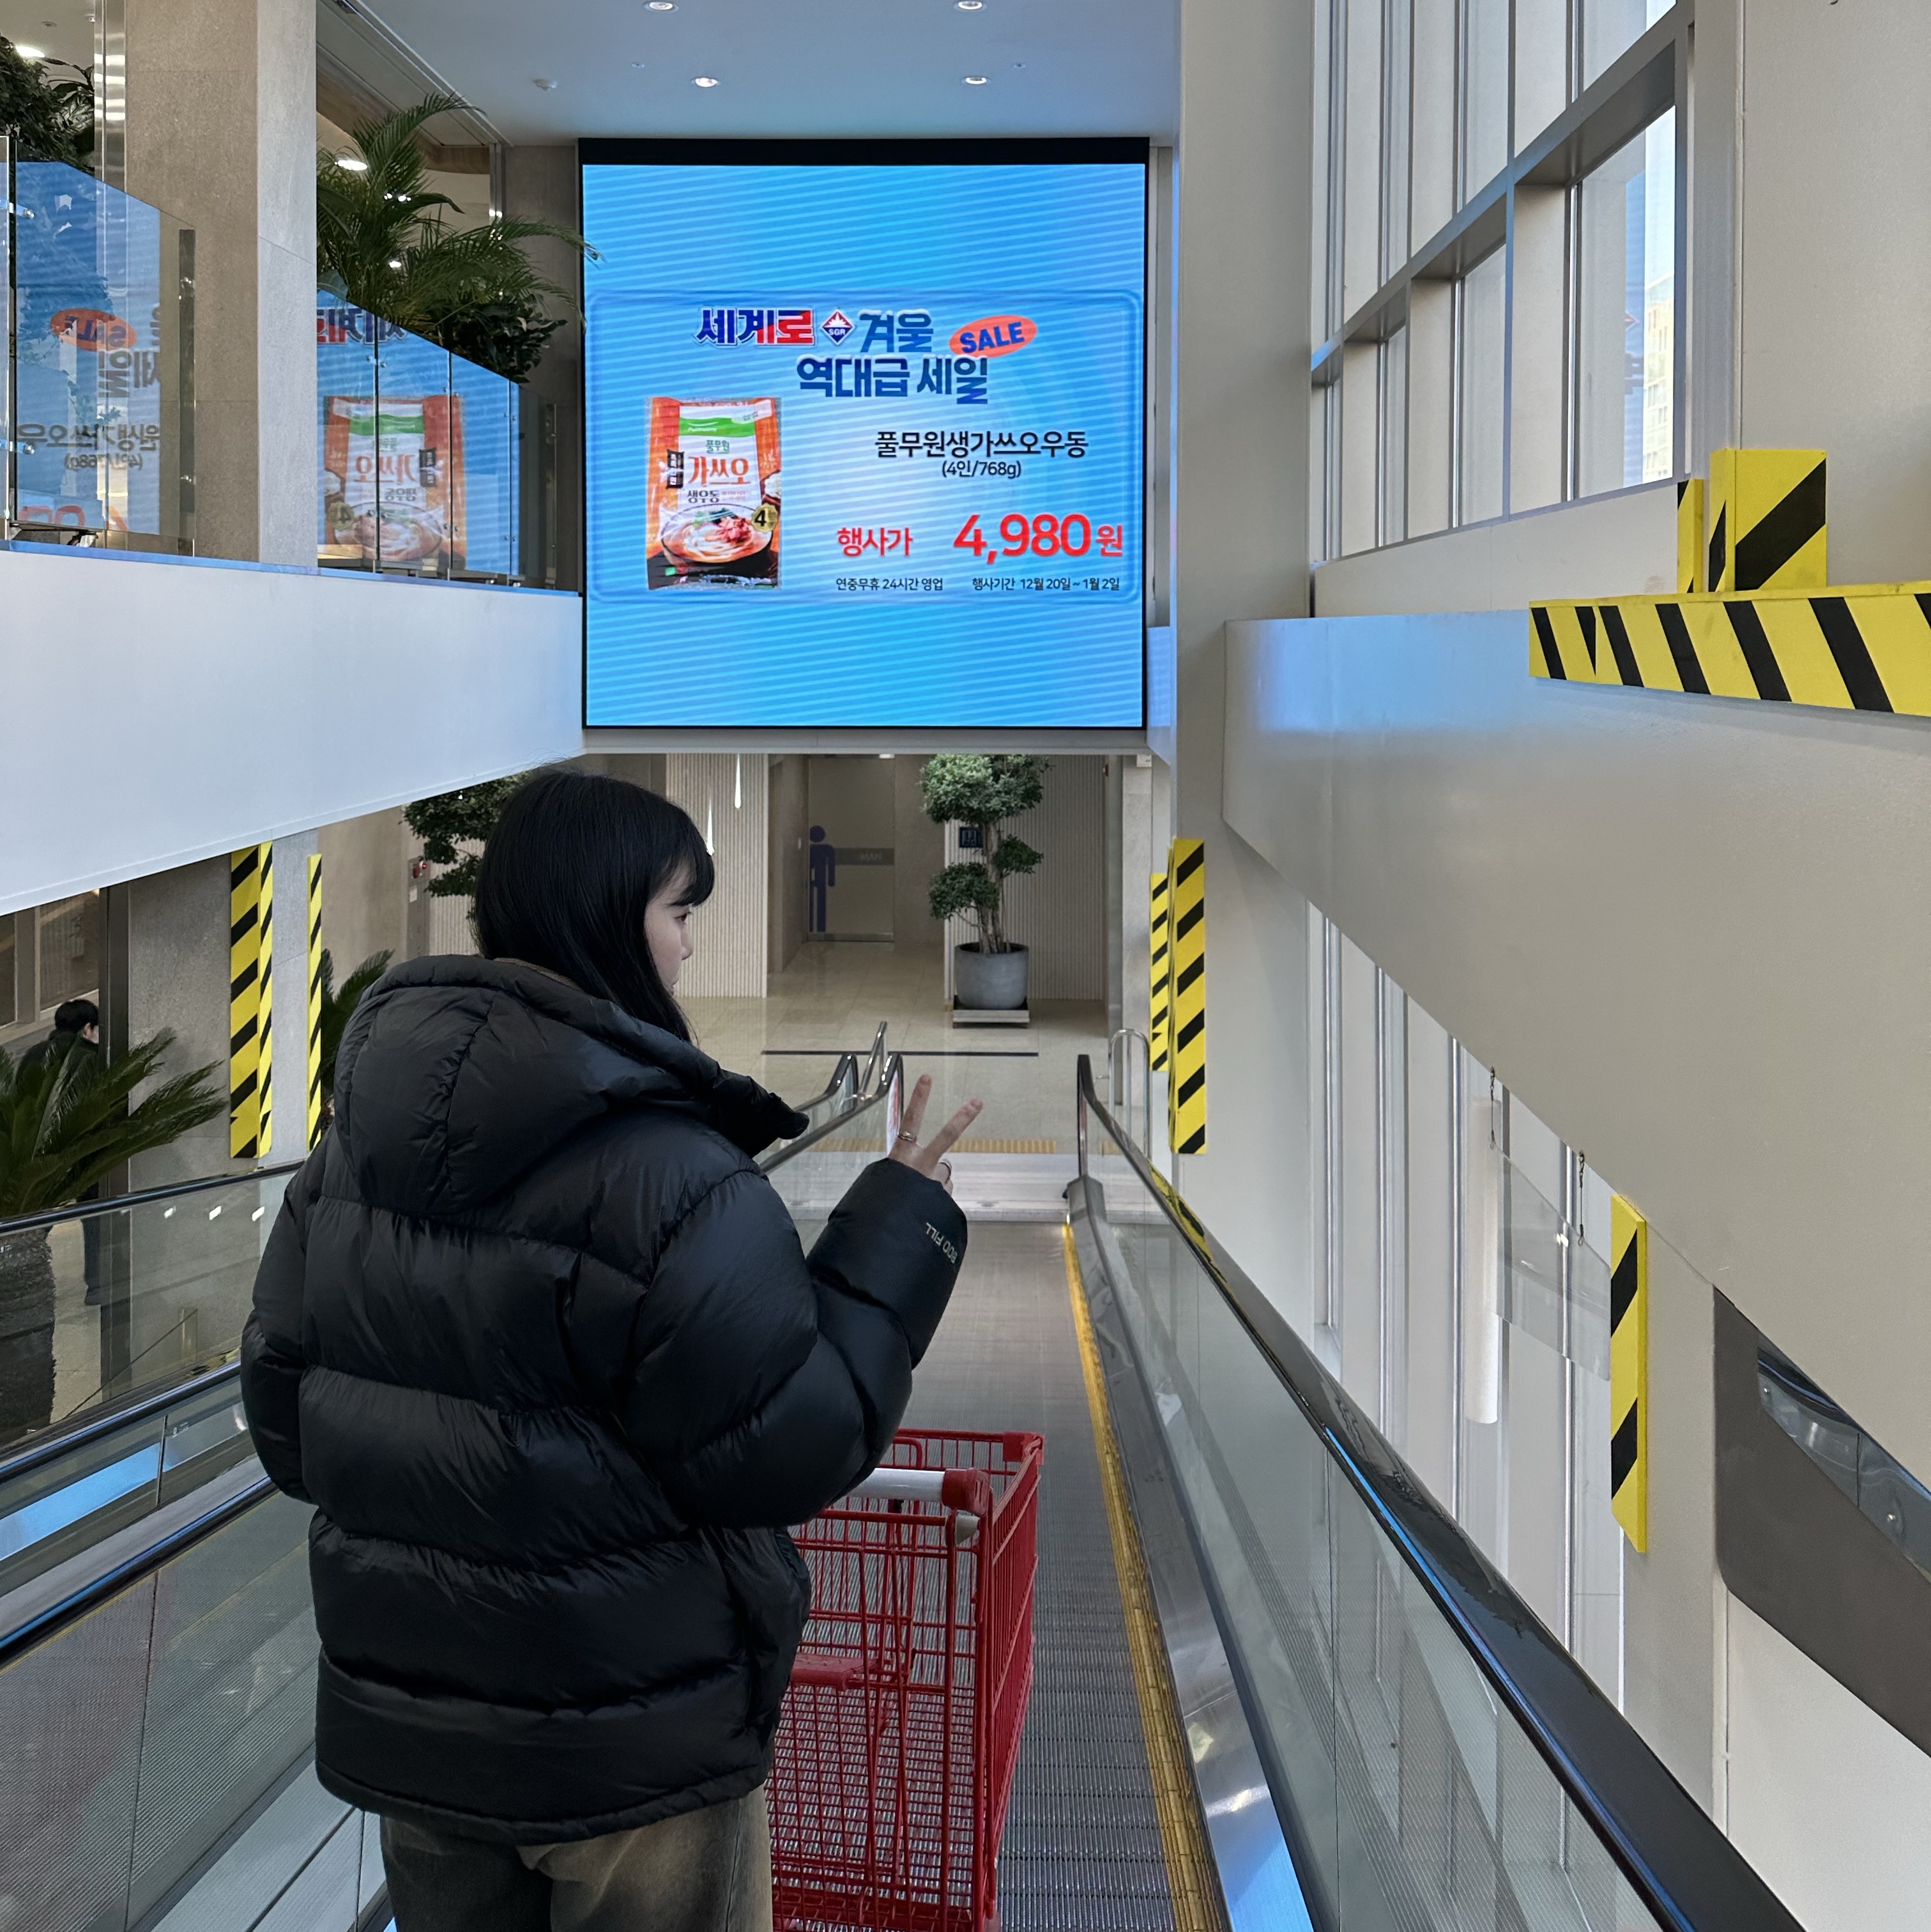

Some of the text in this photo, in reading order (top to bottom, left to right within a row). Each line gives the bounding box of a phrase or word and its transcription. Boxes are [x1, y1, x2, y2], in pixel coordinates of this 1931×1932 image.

[695, 308, 814, 346] 세계로
[859, 309, 934, 353] 겨울
[959, 321, 1025, 353] SALE
[797, 355, 988, 404] 역대급 세일
[705, 440, 730, 454] 풀무원
[874, 431, 1089, 458] 풀무원생가쓰오우동
[688, 456, 751, 487] 가쓰오
[942, 460, 1021, 479] (4인/768g)
[687, 490, 720, 503] 생우동
[754, 510, 767, 526] 4
[837, 527, 913, 556] 행사가
[836, 578, 943, 591] 연중무휴 24시간 영업
[972, 578, 1015, 591] 행사기간
[1020, 578, 1044, 590] 12월
[1046, 578, 1071, 590] 20일
[1083, 578, 1099, 590] 1월
[1102, 578, 1120, 590] 2일
[926, 1222, 944, 1246] FILL
